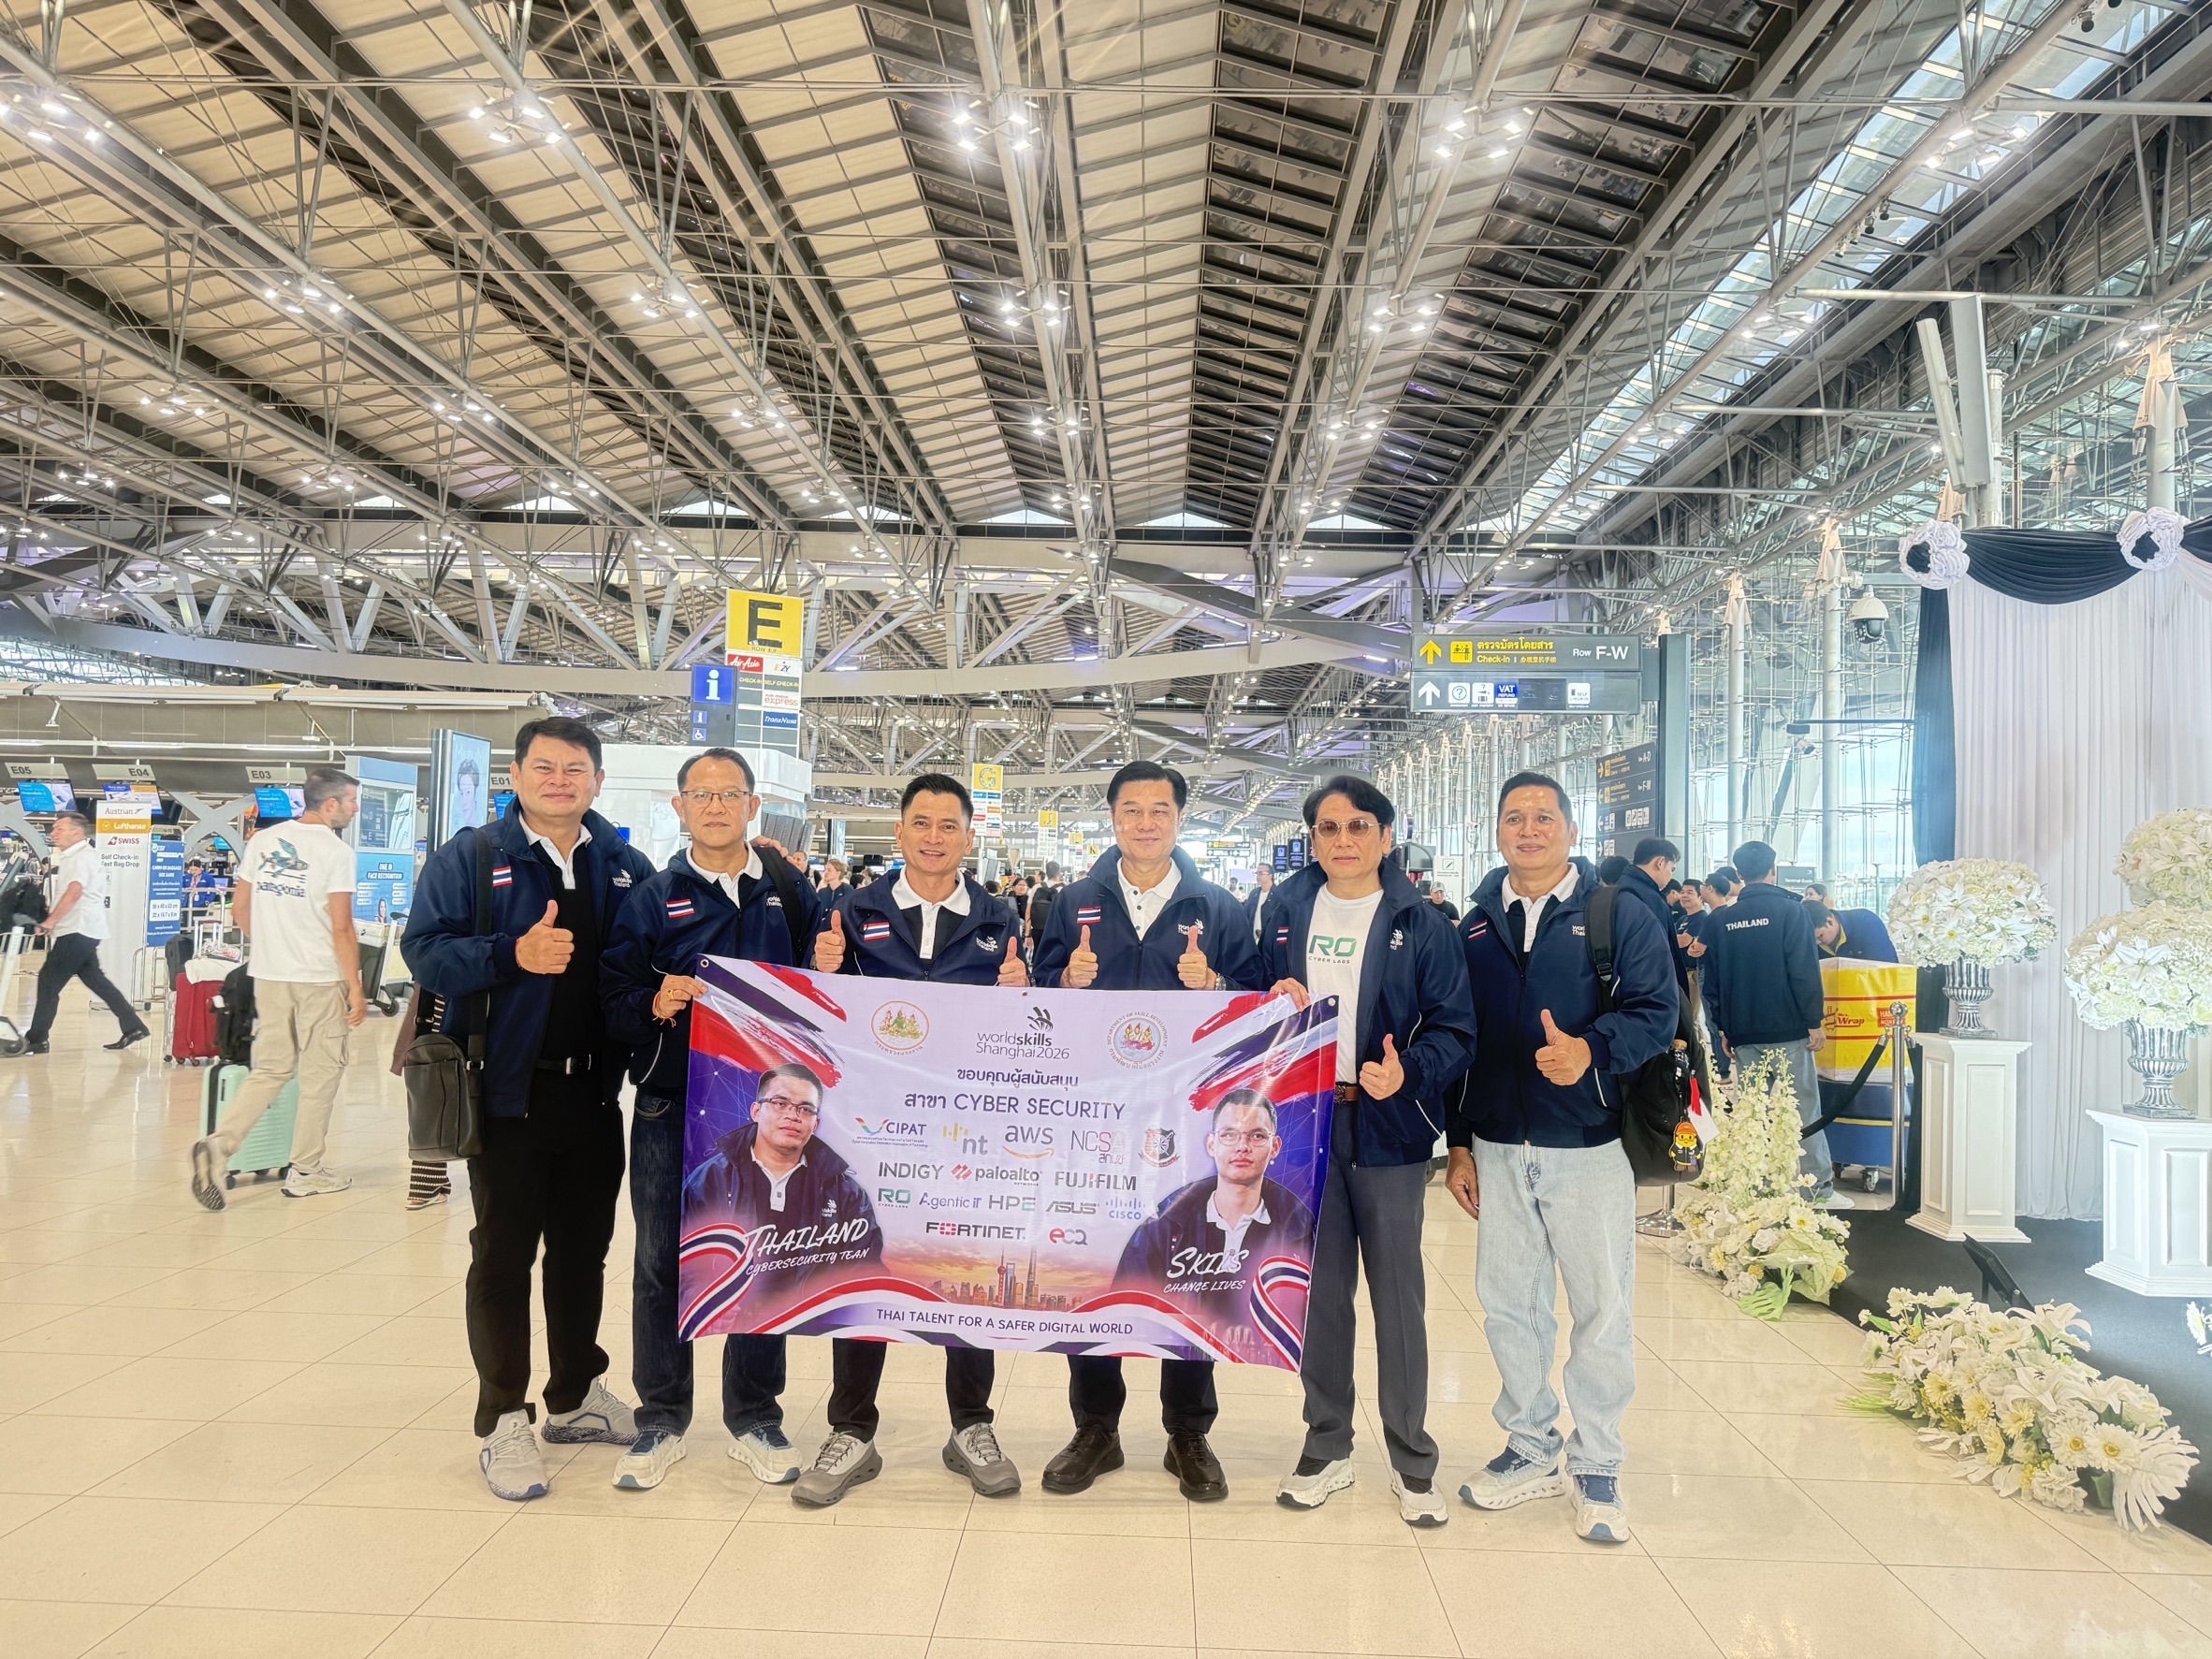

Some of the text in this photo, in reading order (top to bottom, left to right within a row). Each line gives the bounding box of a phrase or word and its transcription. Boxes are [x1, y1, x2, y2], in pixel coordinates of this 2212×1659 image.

[748, 599, 783, 648] E
[1477, 637, 1554, 649] ตรวจบัตรโดยสาร
[1573, 646, 1629, 660] Row F-W
[1499, 684, 1516, 693] VAT
[764, 697, 798, 706] express
[764, 716, 797, 724] TransNusa
[10, 765, 32, 775] E05
[128, 768, 150, 777] E04
[251, 770, 272, 779] E03
[979, 767, 997, 788] G
[491, 777, 511, 785] E01
[1725, 918, 1769, 931] THAILAND
[1308, 934, 1357, 956] RO
[1837, 1016, 1865, 1026] Wrap
[977, 1031, 1052, 1047] worldskills
[956, 1069, 1079, 1091] ขอบคุณผู้สนับสนุน
[904, 1093, 1126, 1120] สาขา CYBER SECURITY
[885, 1122, 927, 1135] CIPAT
[1004, 1125, 1054, 1144] aws
[962, 1135, 988, 1156] nt
[879, 1161, 944, 1180] INDIGY
[975, 1166, 1040, 1182] paloalto
[1055, 1171, 1137, 1190] FUJIFILM
[878, 1187, 910, 1203] RO
[919, 1192, 969, 1209] Agentic
[988, 1194, 1036, 1211] HPE
[1045, 1201, 1097, 1215] ASUS
[1108, 1211, 1142, 1220] CISCO
[744, 1218, 869, 1258] THAILAND
[745, 1251, 838, 1276] CYBERSECURITY
[1163, 1280, 1246, 1294] CHANGE LIVES
[876, 1308, 1133, 1334] THAI TALENT FOR A SAFER DIGITAL WORLD
